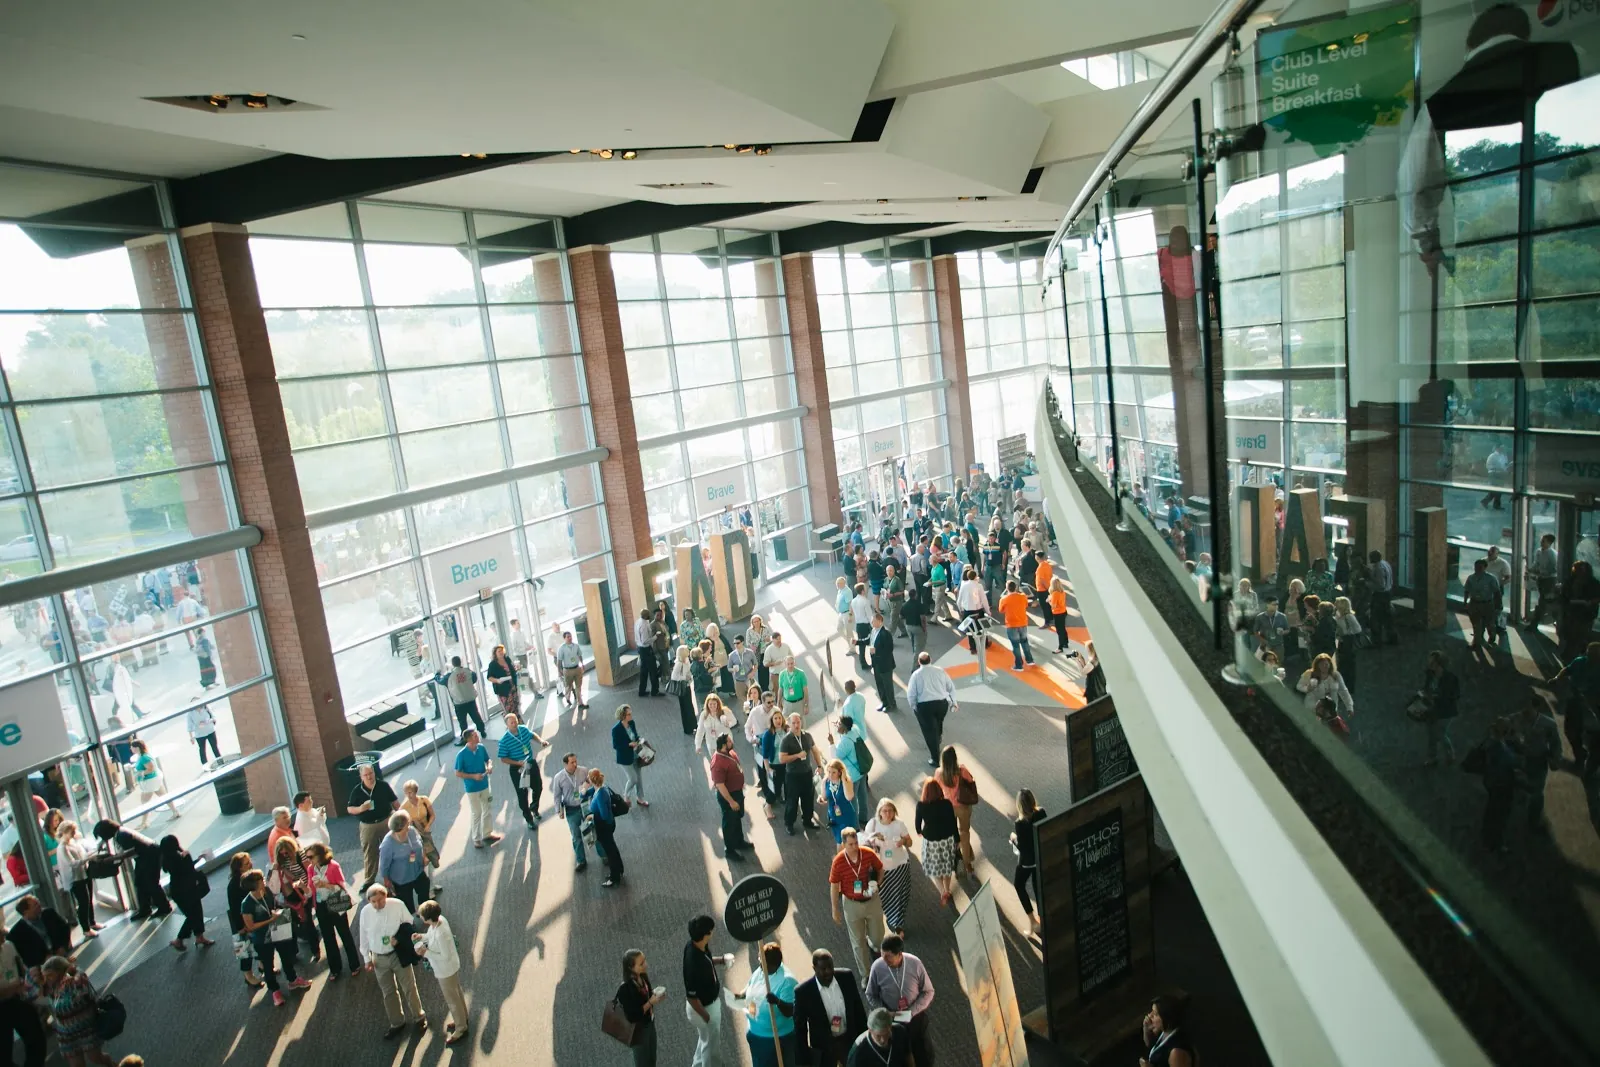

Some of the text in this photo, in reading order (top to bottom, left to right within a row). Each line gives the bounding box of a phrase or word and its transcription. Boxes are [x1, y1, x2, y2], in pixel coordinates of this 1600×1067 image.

[1271, 40, 1368, 73] Club Level
[1272, 73, 1320, 93] Suite
[1273, 84, 1362, 113] Breakfast
[875, 440, 895, 453] Brave
[707, 484, 735, 501] Brave
[451, 558, 498, 585] Brave
[1072, 820, 1121, 856] ETHOS
[734, 887, 774, 910] LET ME HELP
[741, 899, 771, 918] YOU FIND
[741, 909, 775, 931] YOUR SEAT
